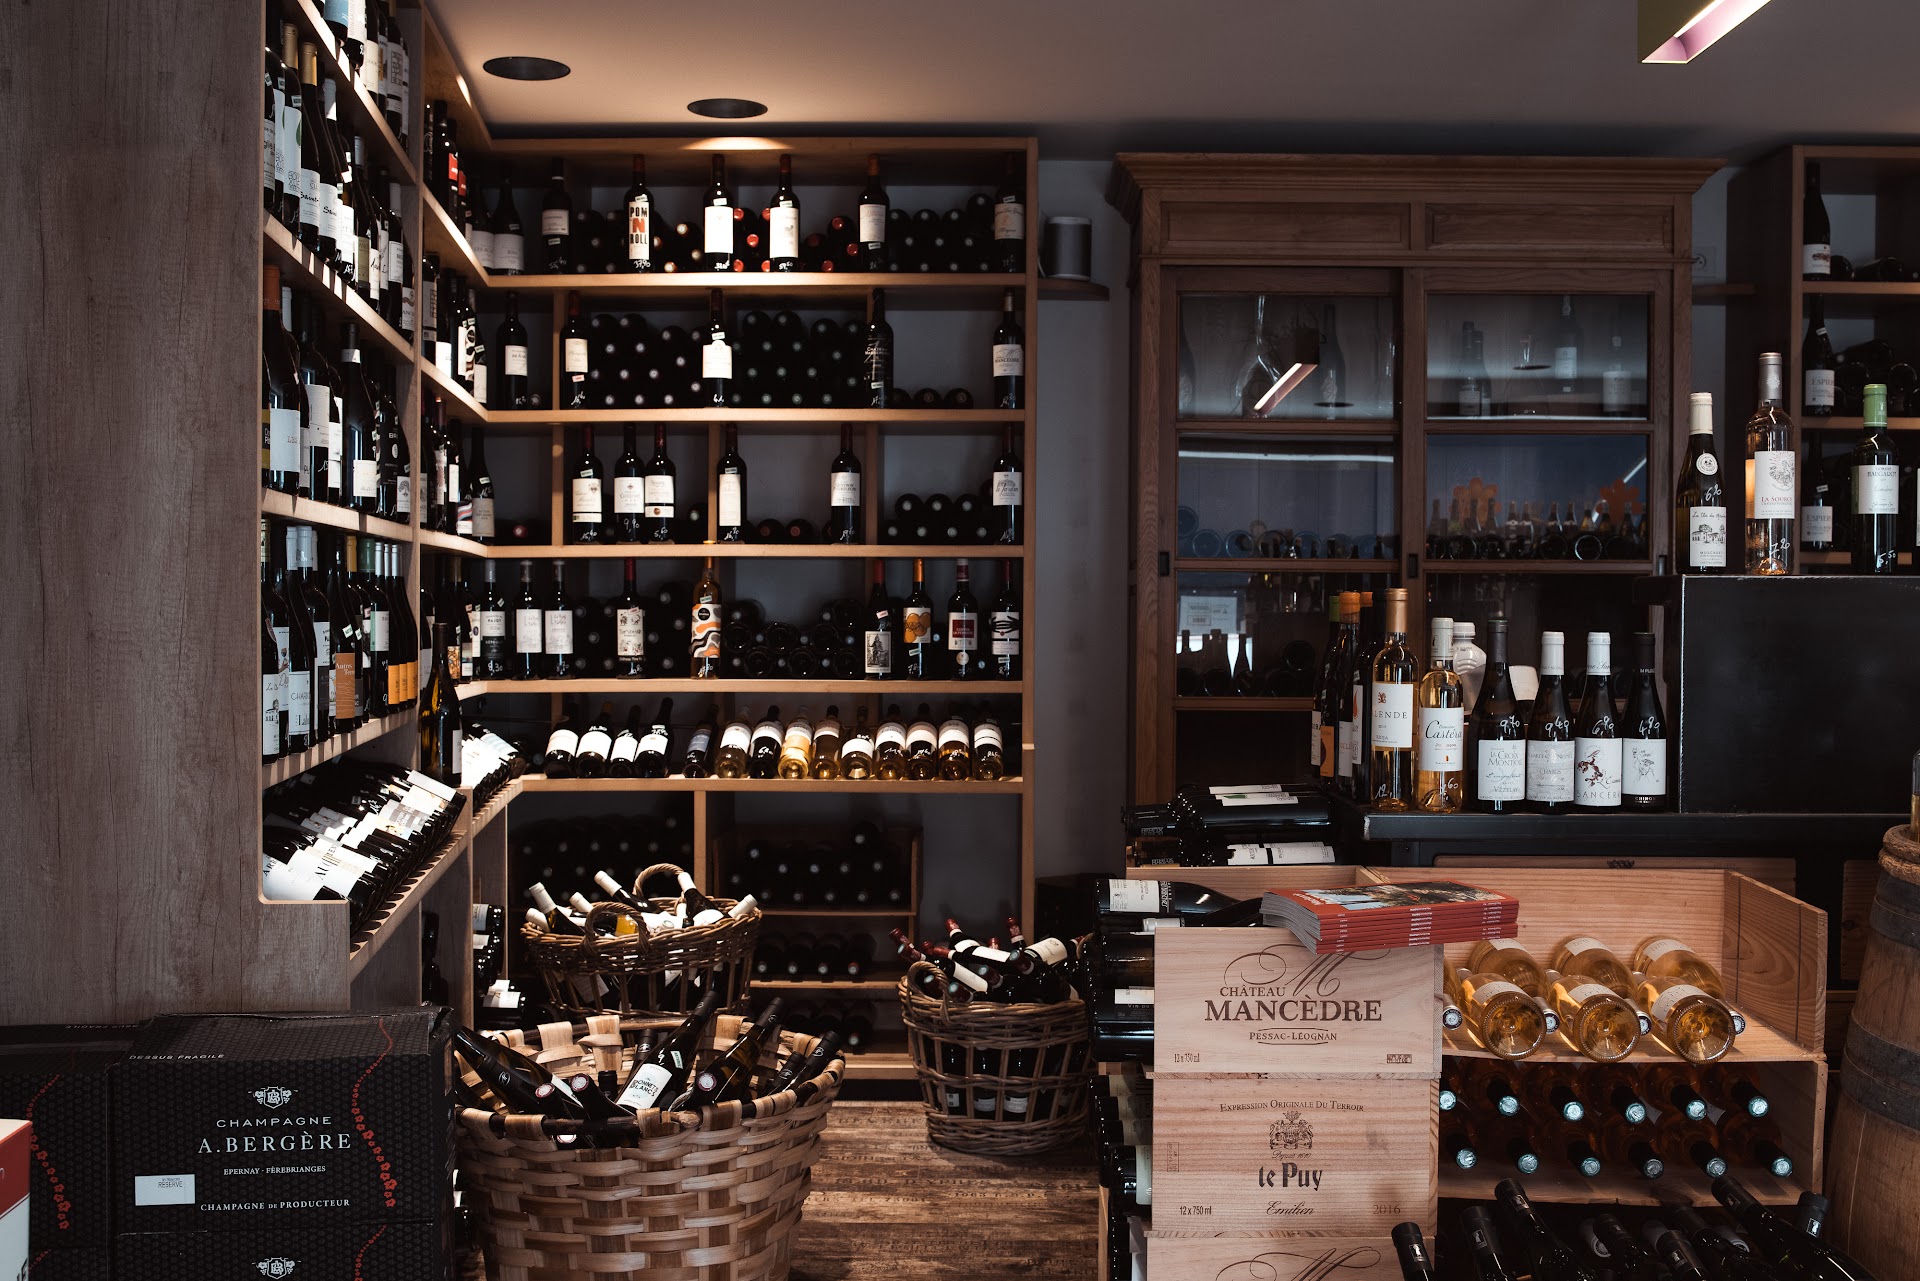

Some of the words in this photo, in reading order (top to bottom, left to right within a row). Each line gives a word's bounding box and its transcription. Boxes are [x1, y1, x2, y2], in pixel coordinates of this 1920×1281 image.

[630, 206, 648, 217] POM
[630, 234, 648, 244] ROLL
[1220, 984, 1286, 997] CHÂTEAU
[1205, 995, 1382, 1021] MANCÈDRE
[1249, 1031, 1337, 1041] PESSAC-LÉOGNAN
[216, 1116, 332, 1128] CHAMPAGNE
[198, 1131, 351, 1153] A.BERGÈRE
[223, 1167, 260, 1176] EPERNAY
[1259, 1166, 1275, 1188] le
[1282, 1162, 1323, 1191] Puy
[200, 1202, 265, 1211] CHAMPAGNE
[280, 1199, 350, 1210] PRODUCTEUR
[1179, 1205, 1188, 1216] 12
[1192, 1205, 1204, 1216] 750
[1204, 1205, 1212, 1215] ml
[1266, 1200, 1316, 1216] Emilien
[1372, 1204, 1401, 1215] 2016
